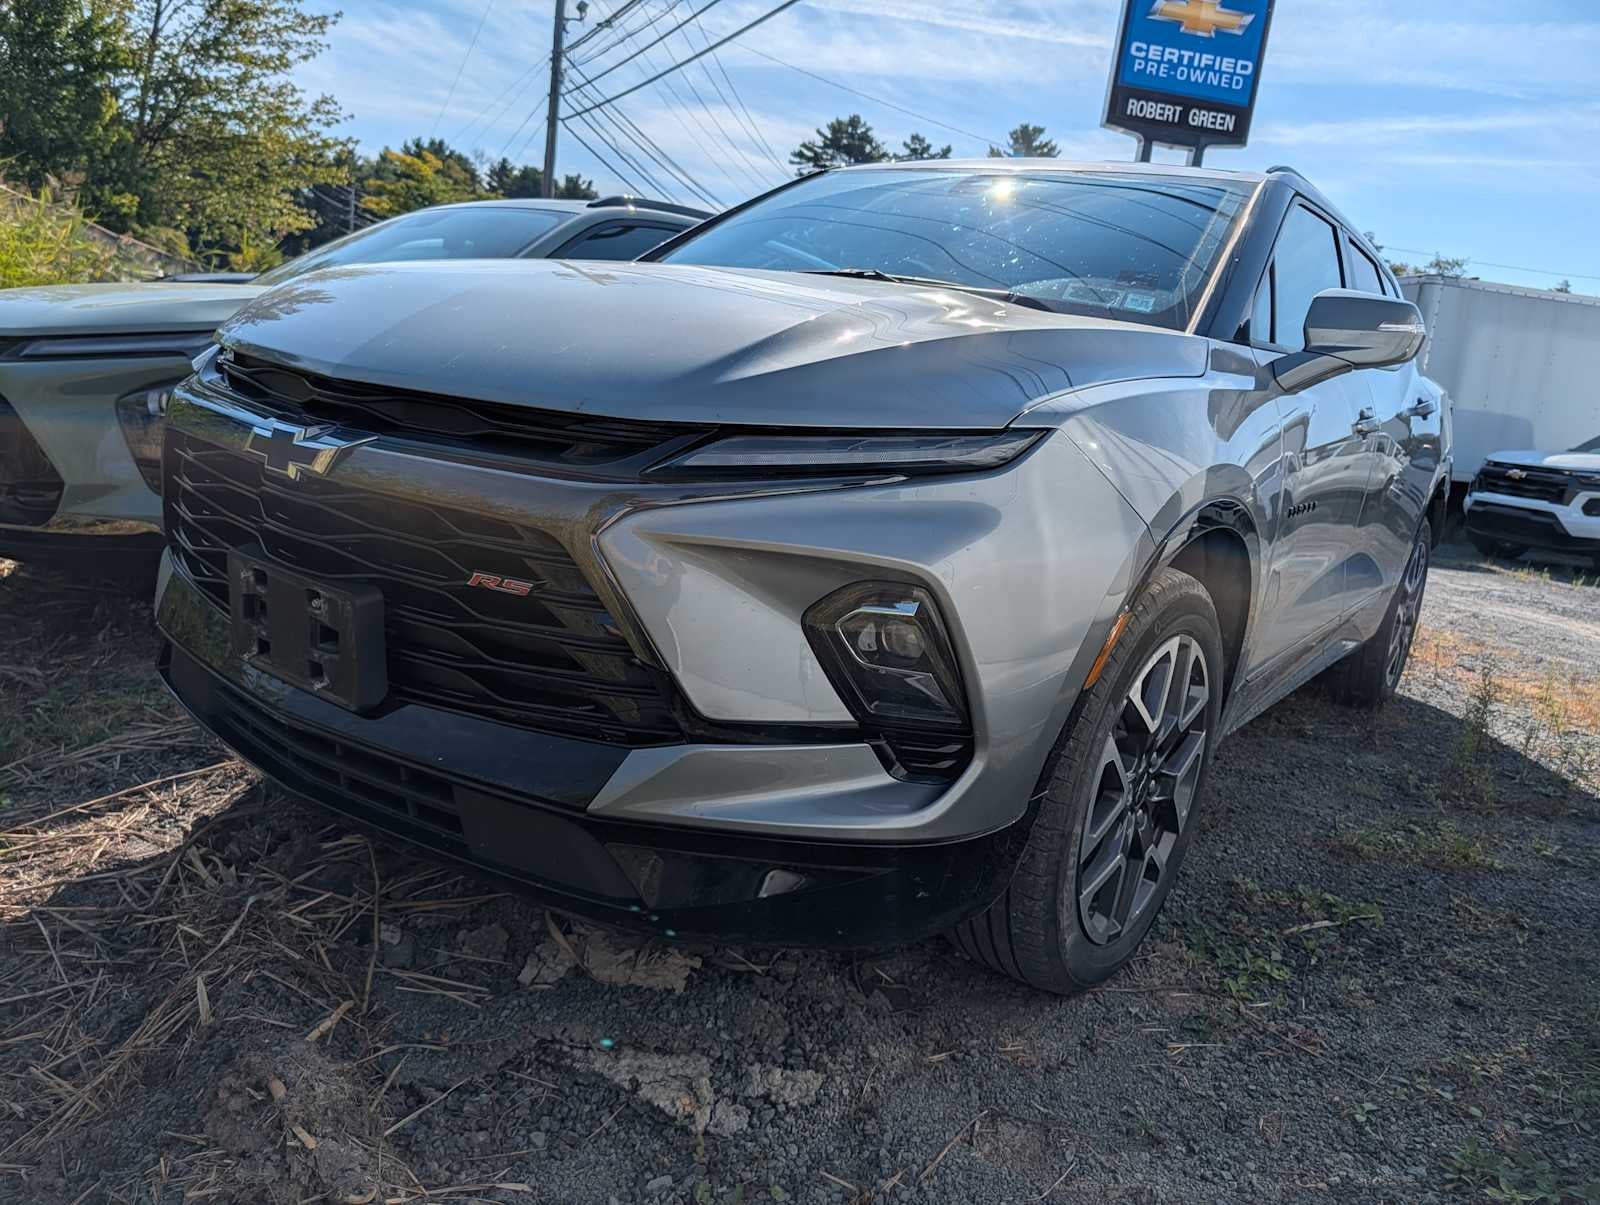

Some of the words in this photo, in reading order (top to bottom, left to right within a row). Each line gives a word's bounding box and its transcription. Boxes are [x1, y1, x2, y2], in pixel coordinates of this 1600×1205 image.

[1130, 41, 1253, 75] CERTIFIED
[1133, 59, 1244, 90] PRE-OWNED
[1126, 98, 1183, 123] ROBERT
[1188, 108, 1236, 132] GREEN
[466, 572, 534, 596] RS
